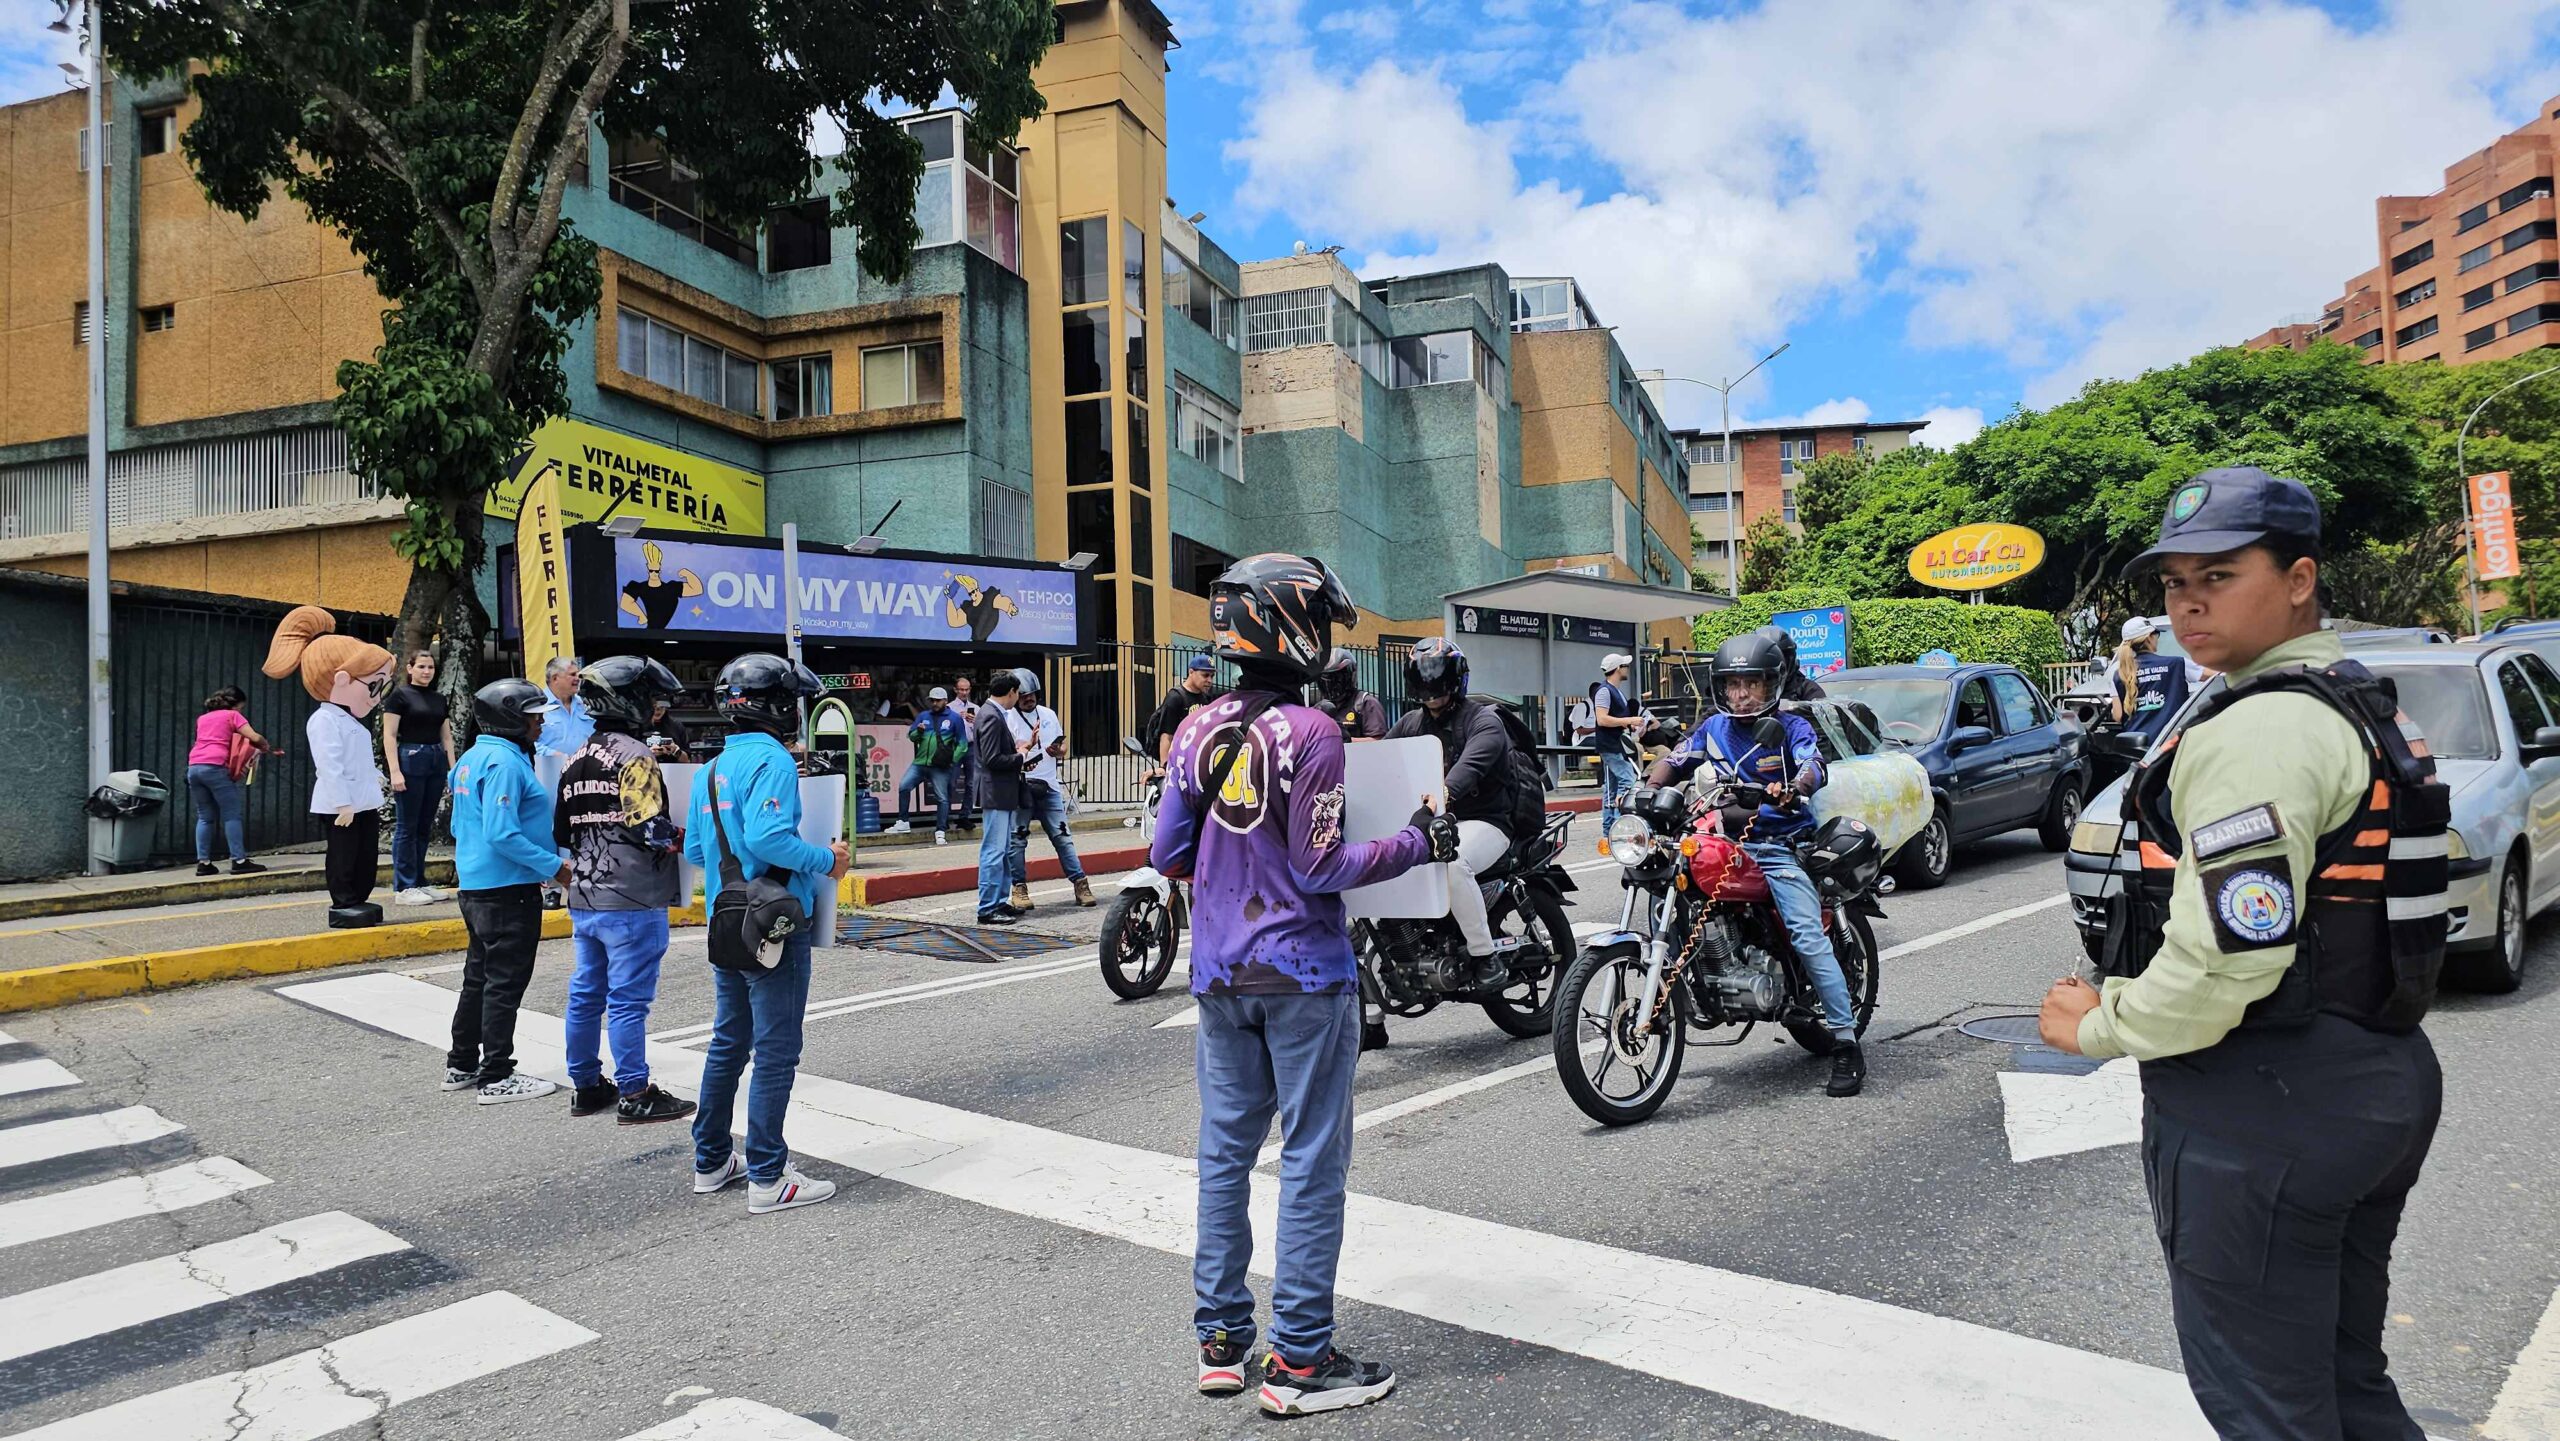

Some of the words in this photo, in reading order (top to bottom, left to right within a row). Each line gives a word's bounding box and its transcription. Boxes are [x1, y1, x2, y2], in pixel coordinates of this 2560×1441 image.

[582, 444, 692, 491] VITALMETAL
[2475, 475, 2512, 581] kontigo
[1926, 551, 1946, 567] Li
[1952, 548, 1990, 564] Car
[1997, 543, 2026, 560] Ch
[536, 504, 559, 657] FERRET
[1931, 562, 2021, 580] AUTOMERCADOS
[708, 571, 776, 609] ON
[799, 576, 850, 613] MY
[857, 580, 944, 617] WAY
[1500, 614, 1509, 624] EL
[1510, 615, 1540, 626] HATILLO
[1790, 626, 1828, 640] Downy
[1795, 639, 1826, 648] ntense
[1796, 652, 1823, 660] LIENDO
[1824, 650, 1842, 658] RICO
[2193, 812, 2274, 850] TRANSITO
